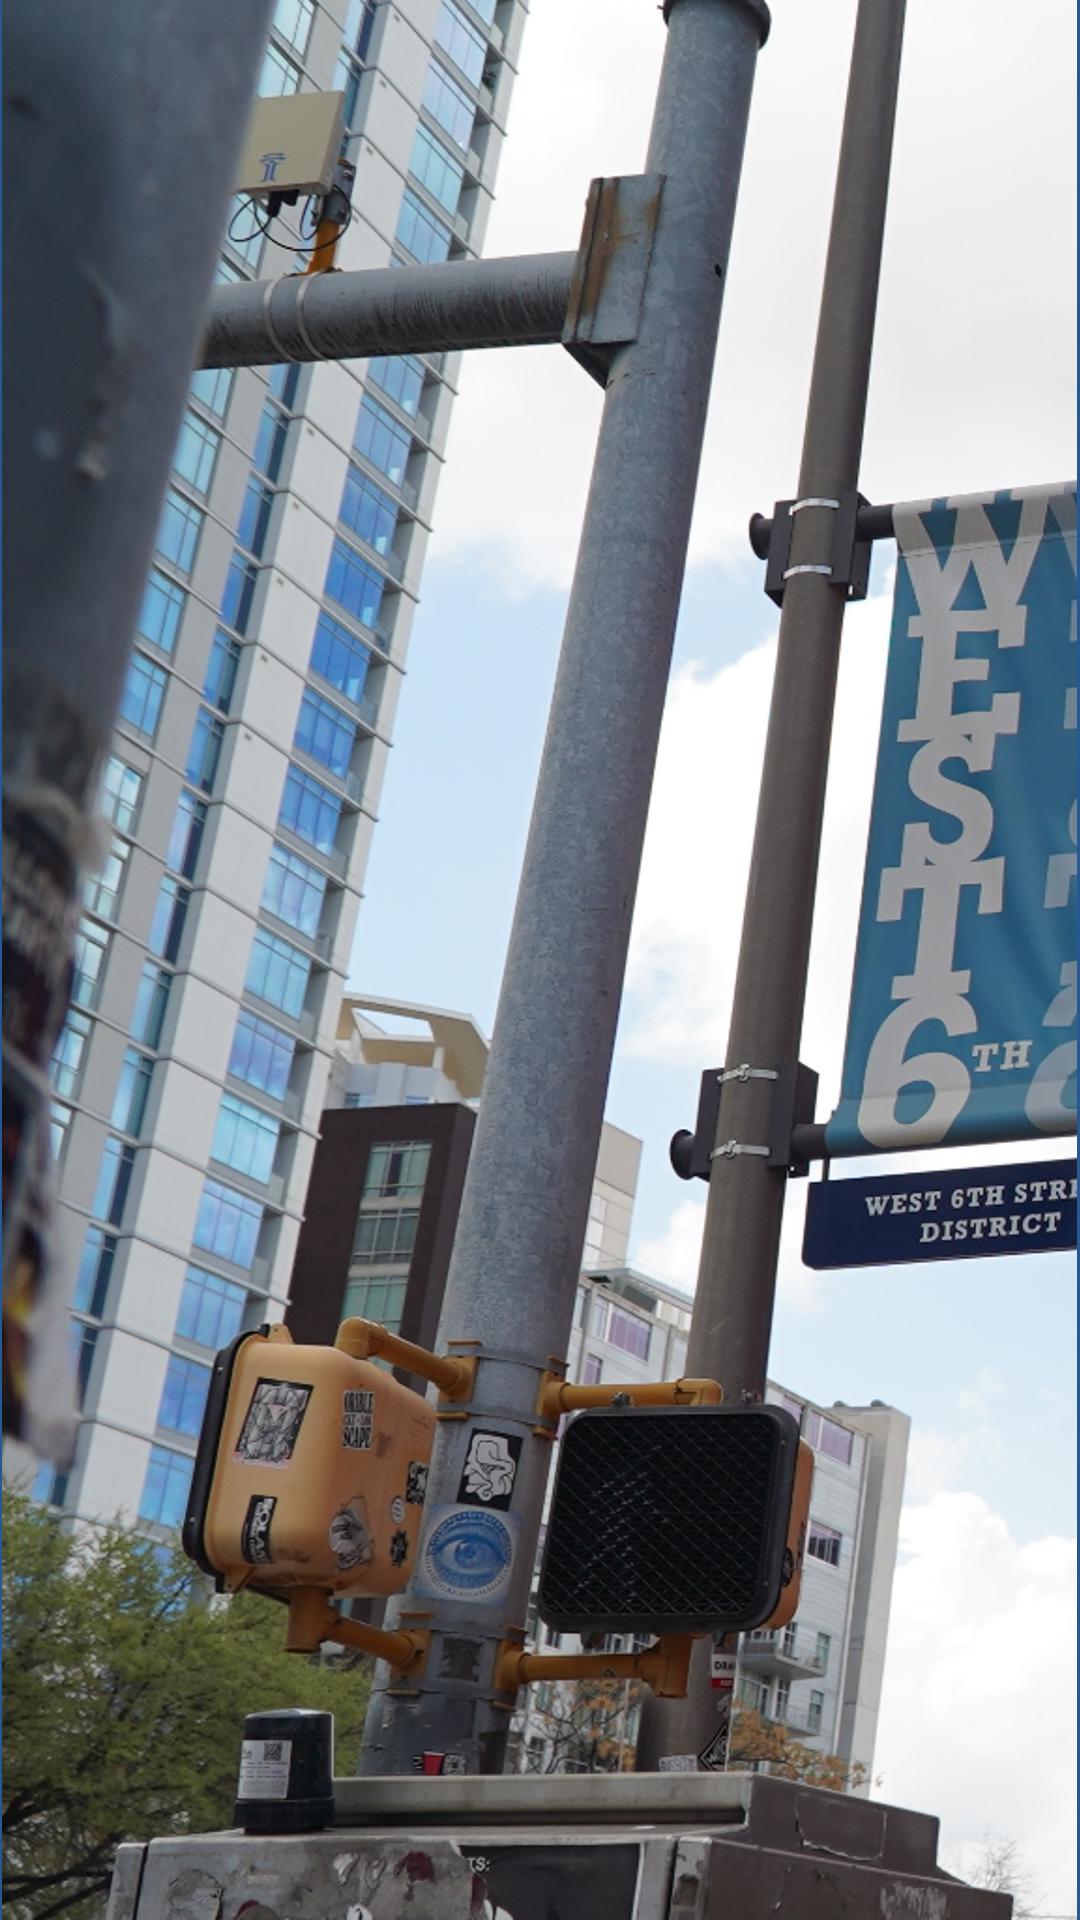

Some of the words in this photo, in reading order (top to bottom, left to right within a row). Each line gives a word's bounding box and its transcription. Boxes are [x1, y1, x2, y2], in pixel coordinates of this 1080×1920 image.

[876, 481, 1064, 1000] WEST
[865, 1191, 941, 1216] WEST
[951, 1185, 1005, 1209] 6TH
[919, 1211, 1062, 1243] DISTRICT
